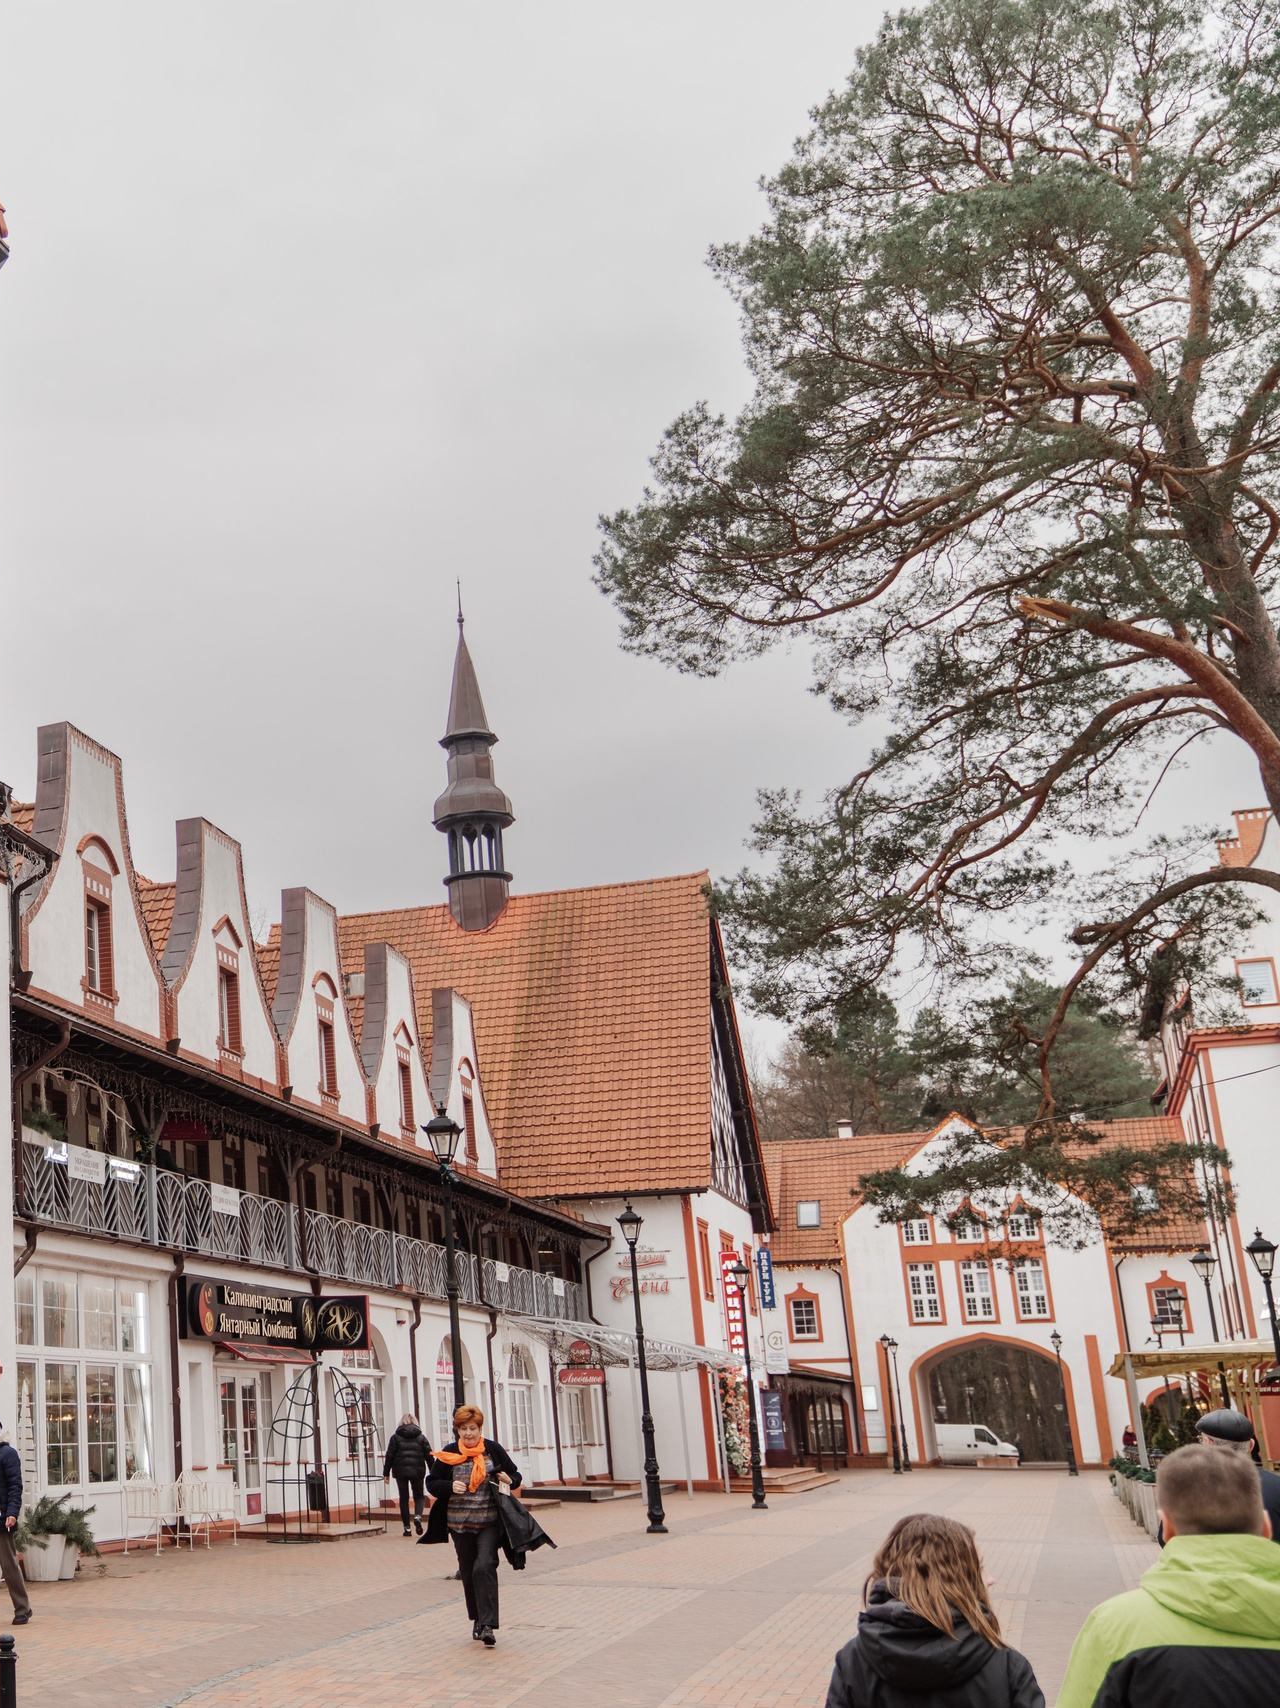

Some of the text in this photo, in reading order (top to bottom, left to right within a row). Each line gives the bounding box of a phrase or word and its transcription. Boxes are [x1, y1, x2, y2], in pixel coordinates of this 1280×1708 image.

[622, 1252, 666, 1264] мгазин
[610, 1277, 670, 1301] Еена
[760, 1252, 771, 1303] ПАРИ ТУР
[224, 1285, 293, 1314] Калининградский
[722, 1260, 745, 1356] МАРЦИПАН
[220, 1313, 260, 1339] Янтарный
[262, 1317, 298, 1340] Комбинат
[561, 1372, 603, 1384] Любимое
